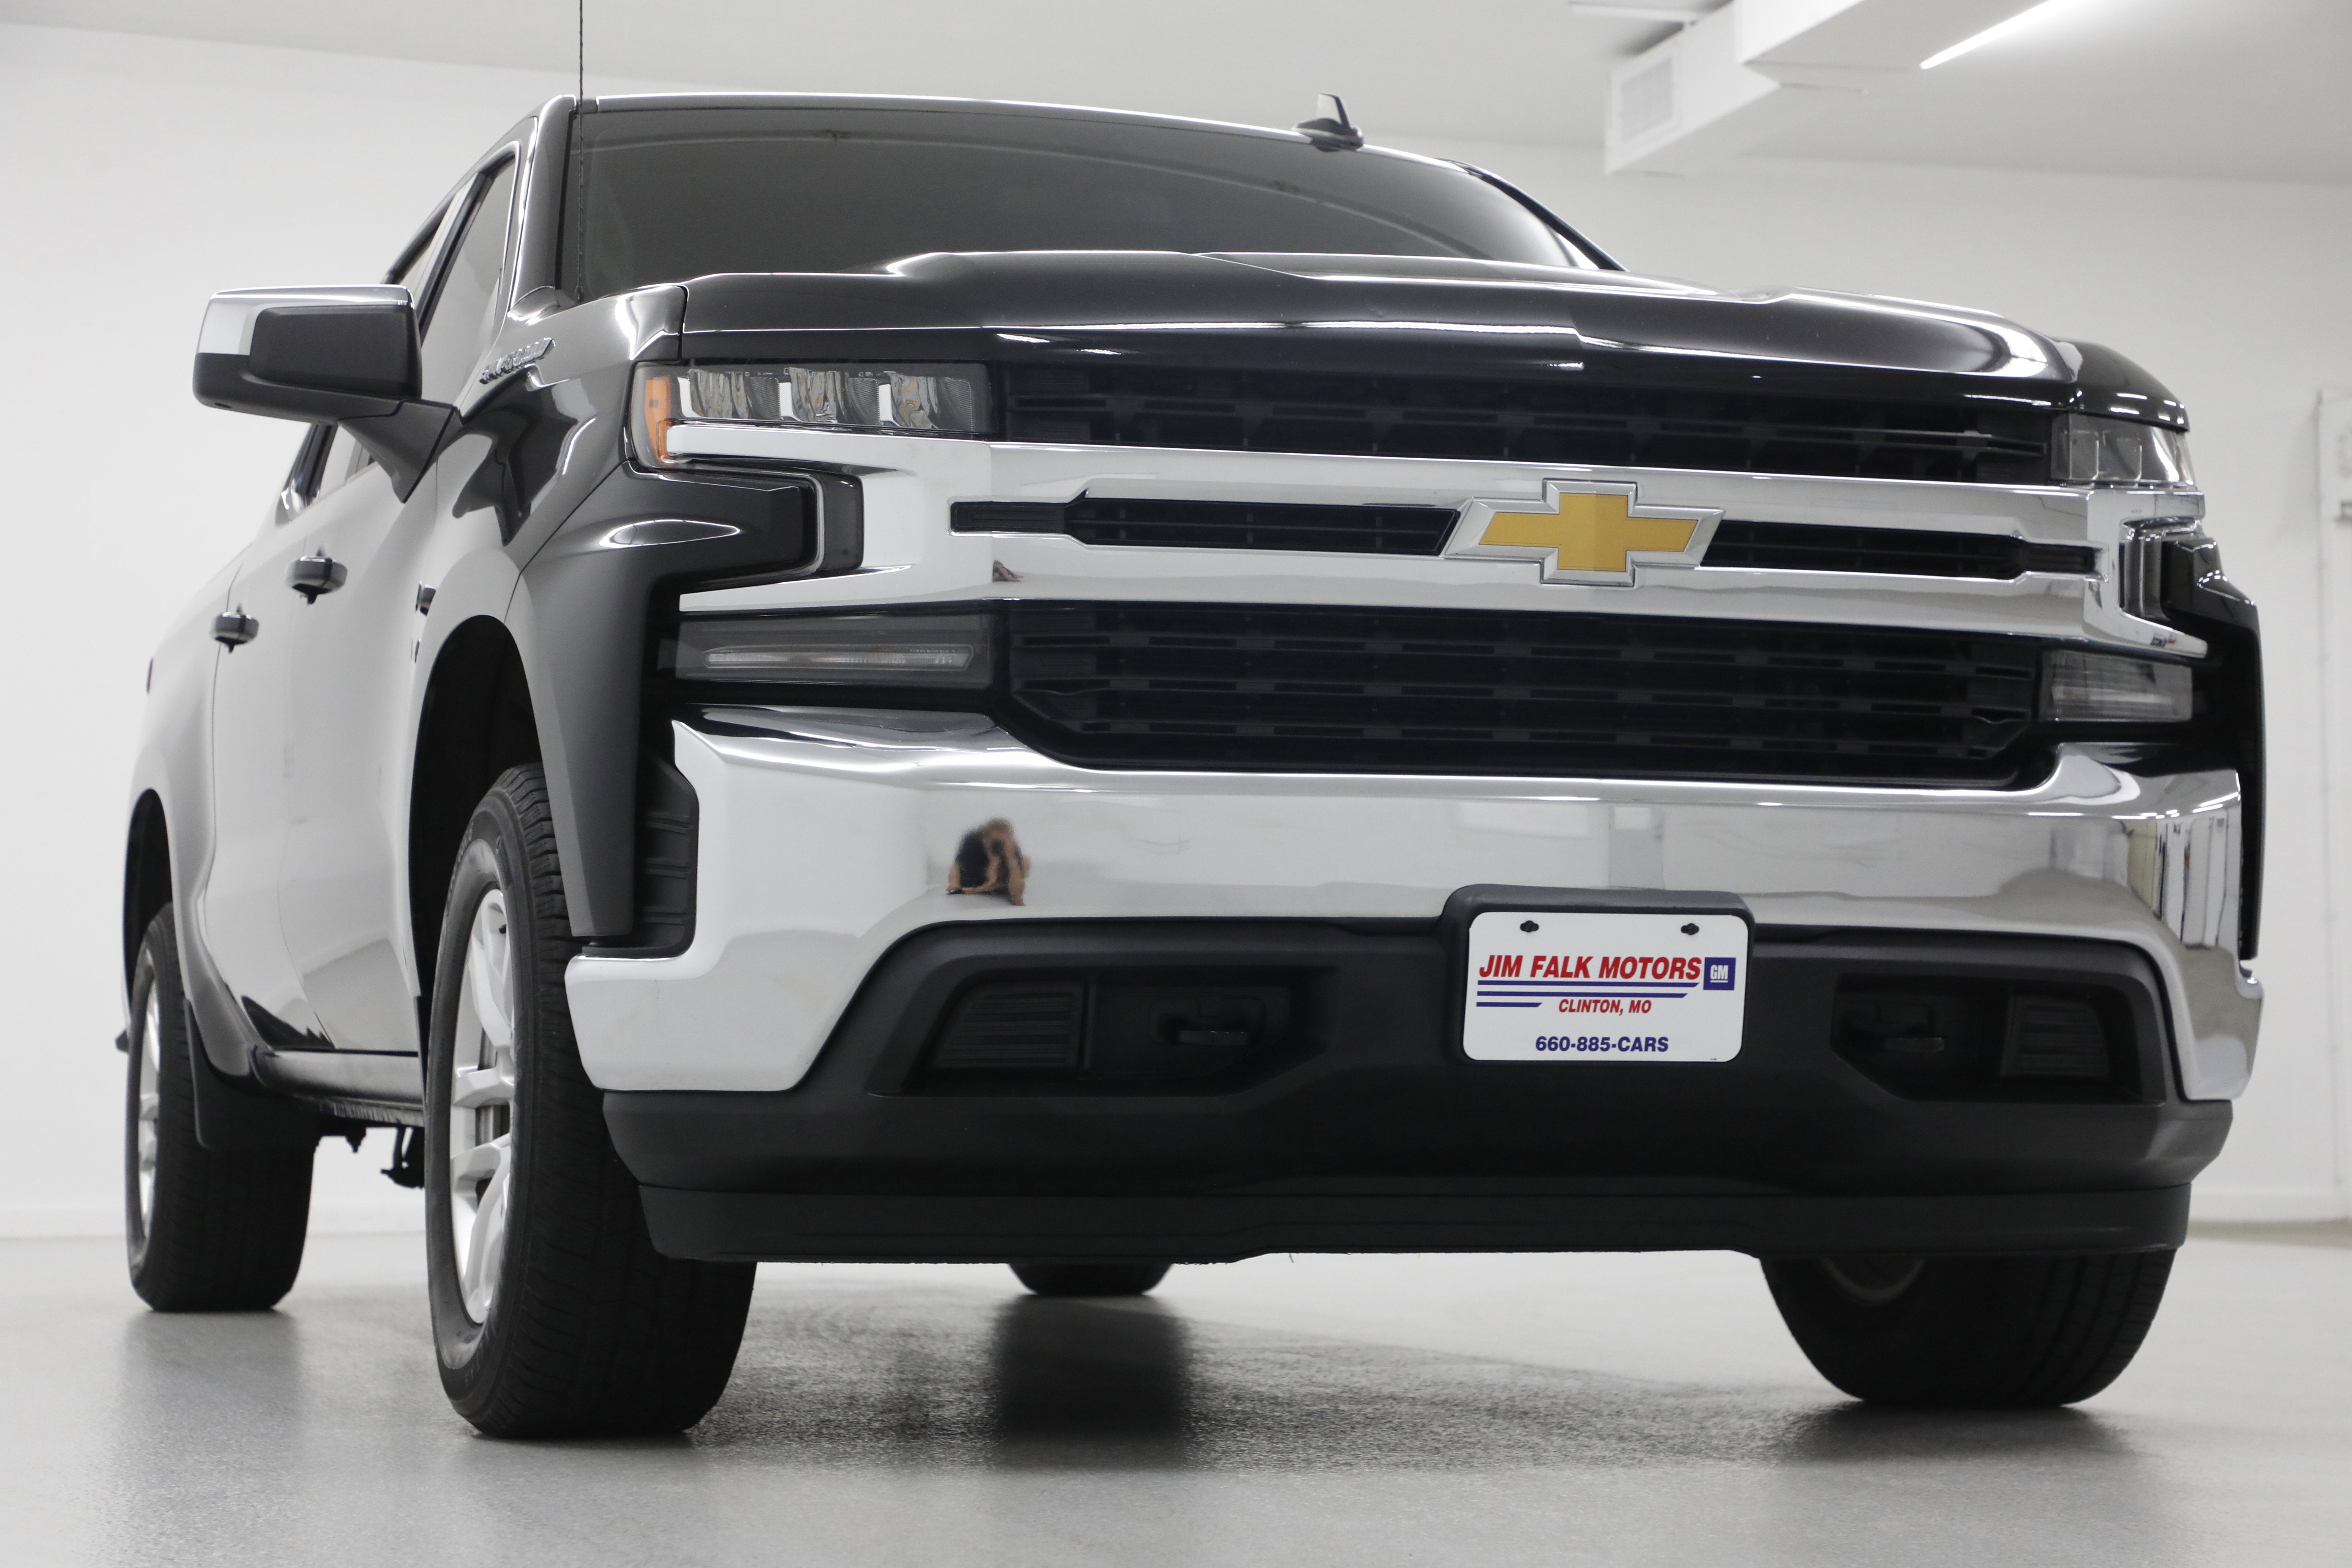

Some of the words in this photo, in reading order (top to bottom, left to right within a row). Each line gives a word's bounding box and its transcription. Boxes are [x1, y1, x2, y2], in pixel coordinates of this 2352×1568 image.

[1479, 954, 1524, 978] JIM
[1530, 955, 1594, 979] FALK
[1598, 956, 1702, 980] MOTORS
[1710, 964, 1729, 980] GM
[1558, 999, 1624, 1016] CLINTON,
[1628, 999, 1653, 1014] MO
[1535, 1036, 1669, 1052] 660-885-CARS
